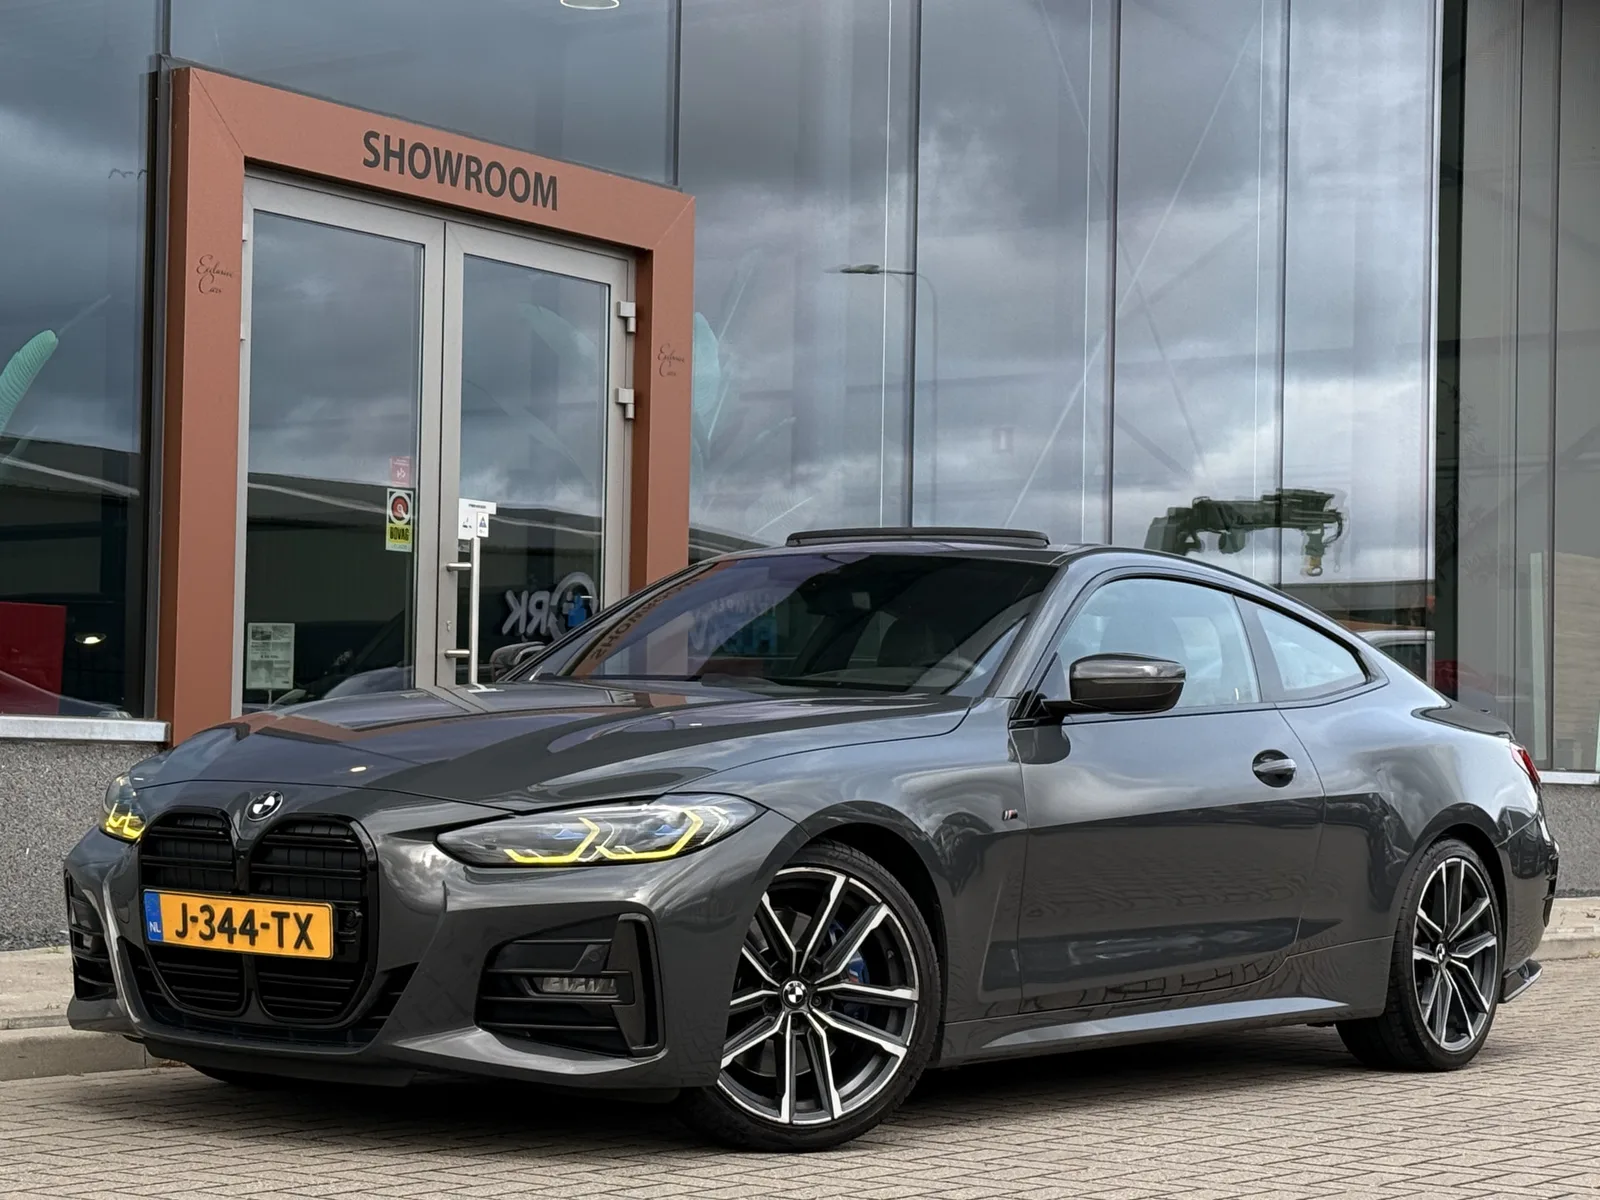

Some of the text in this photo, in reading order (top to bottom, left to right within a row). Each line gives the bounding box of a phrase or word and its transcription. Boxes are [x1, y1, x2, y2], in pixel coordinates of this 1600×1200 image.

[363, 130, 558, 212] SHOWROOM
[149, 921, 162, 934] NL
[175, 902, 315, 951] J-344-TX
